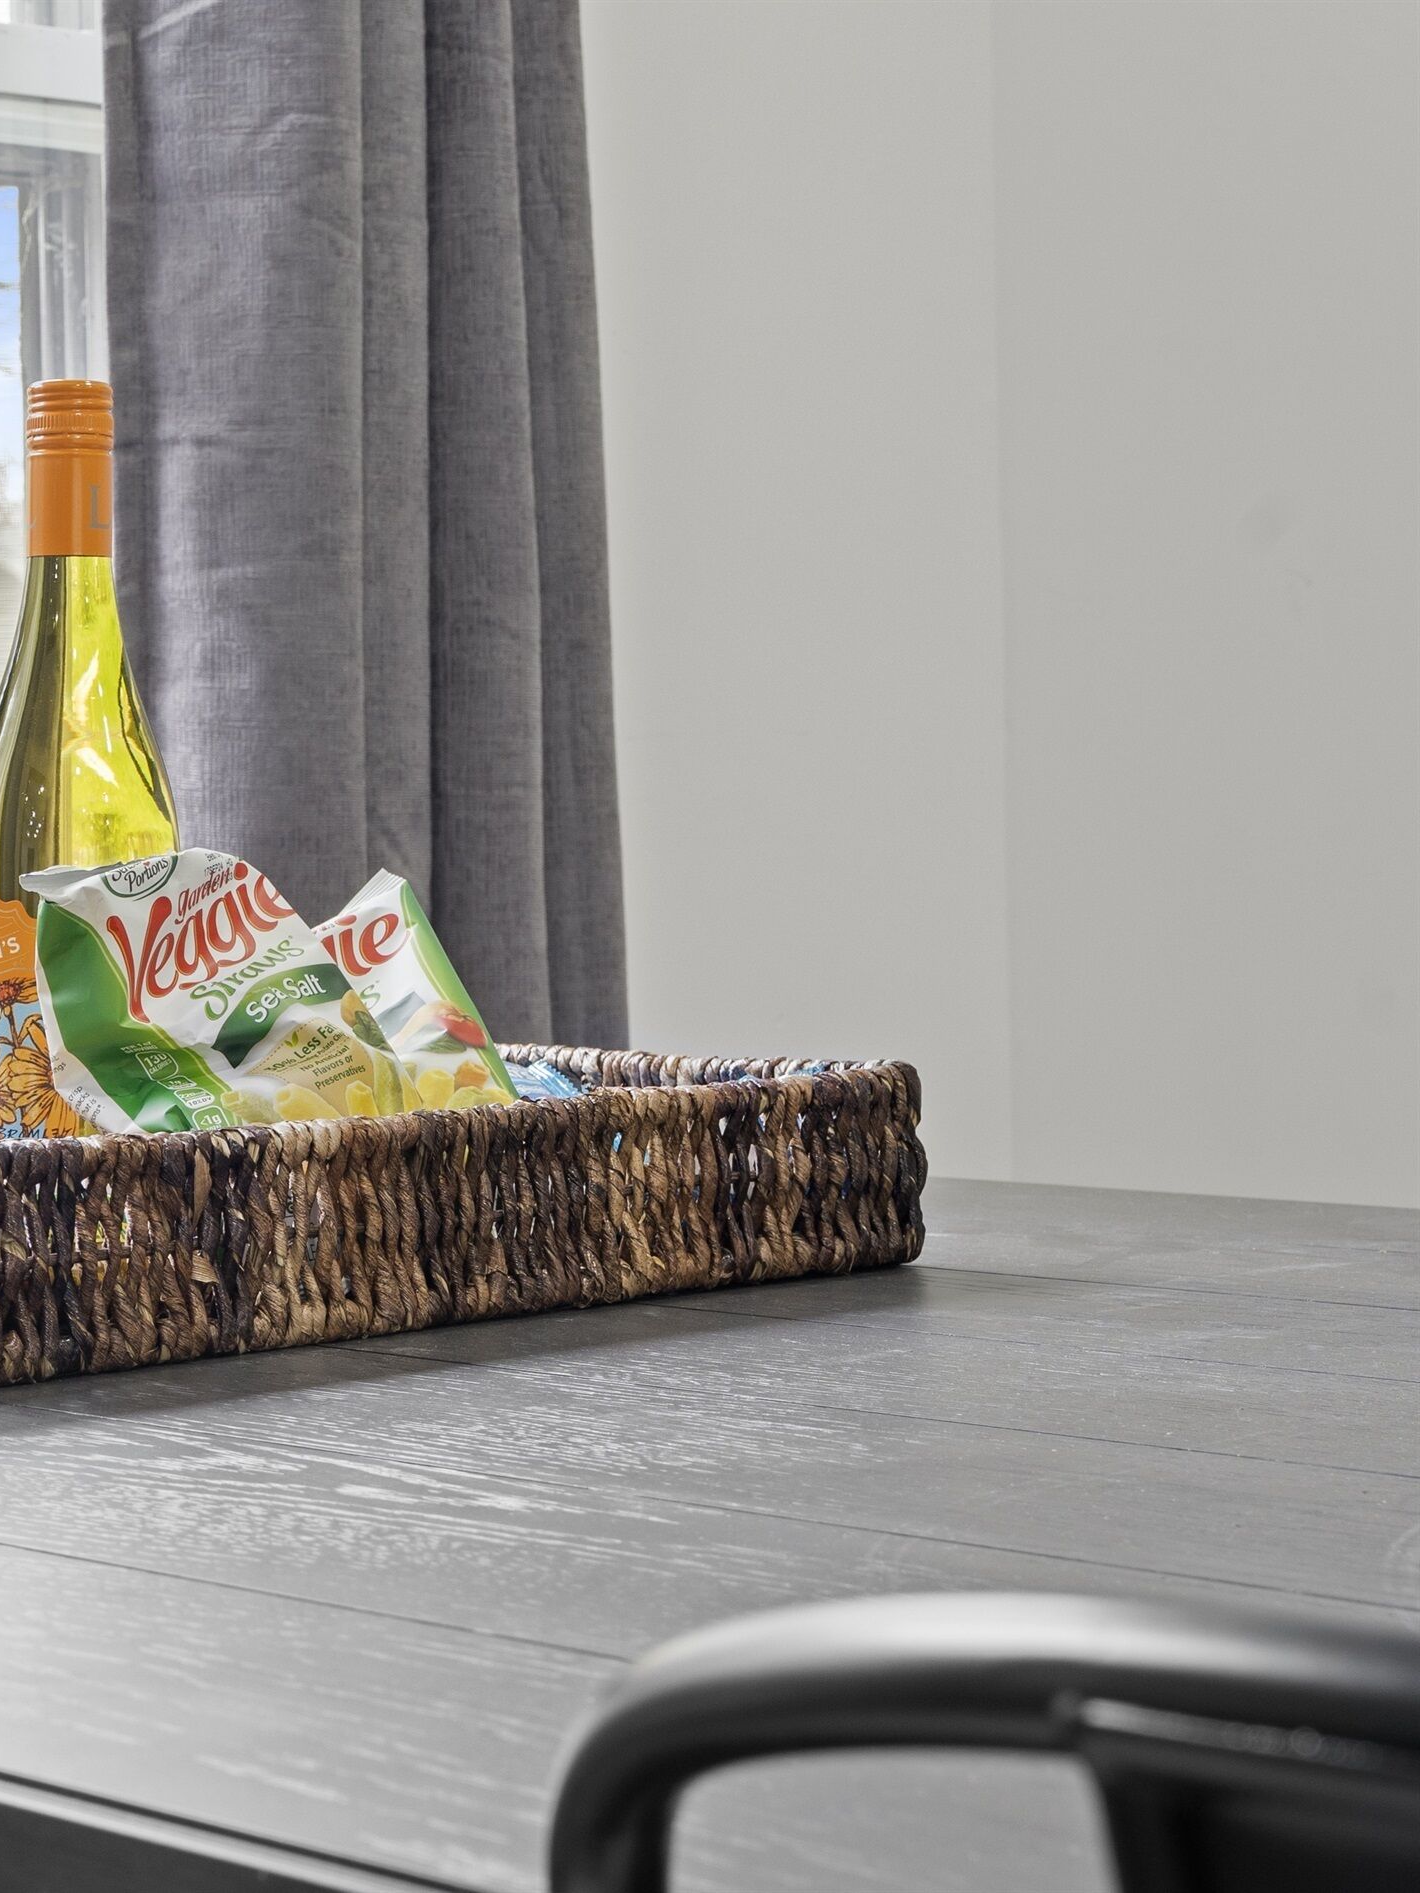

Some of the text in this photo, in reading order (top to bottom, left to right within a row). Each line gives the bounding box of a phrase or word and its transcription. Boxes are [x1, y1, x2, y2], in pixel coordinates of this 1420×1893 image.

[88, 484, 111, 530] L
[106, 862, 295, 1023] Veggie
[245, 985, 288, 1023] Sea
[282, 973, 327, 1000] Salt
[294, 1036, 321, 1059] Less
[312, 1057, 344, 1077] Flavors
[344, 1055, 354, 1065] or
[314, 1064, 366, 1090] Preservatives
